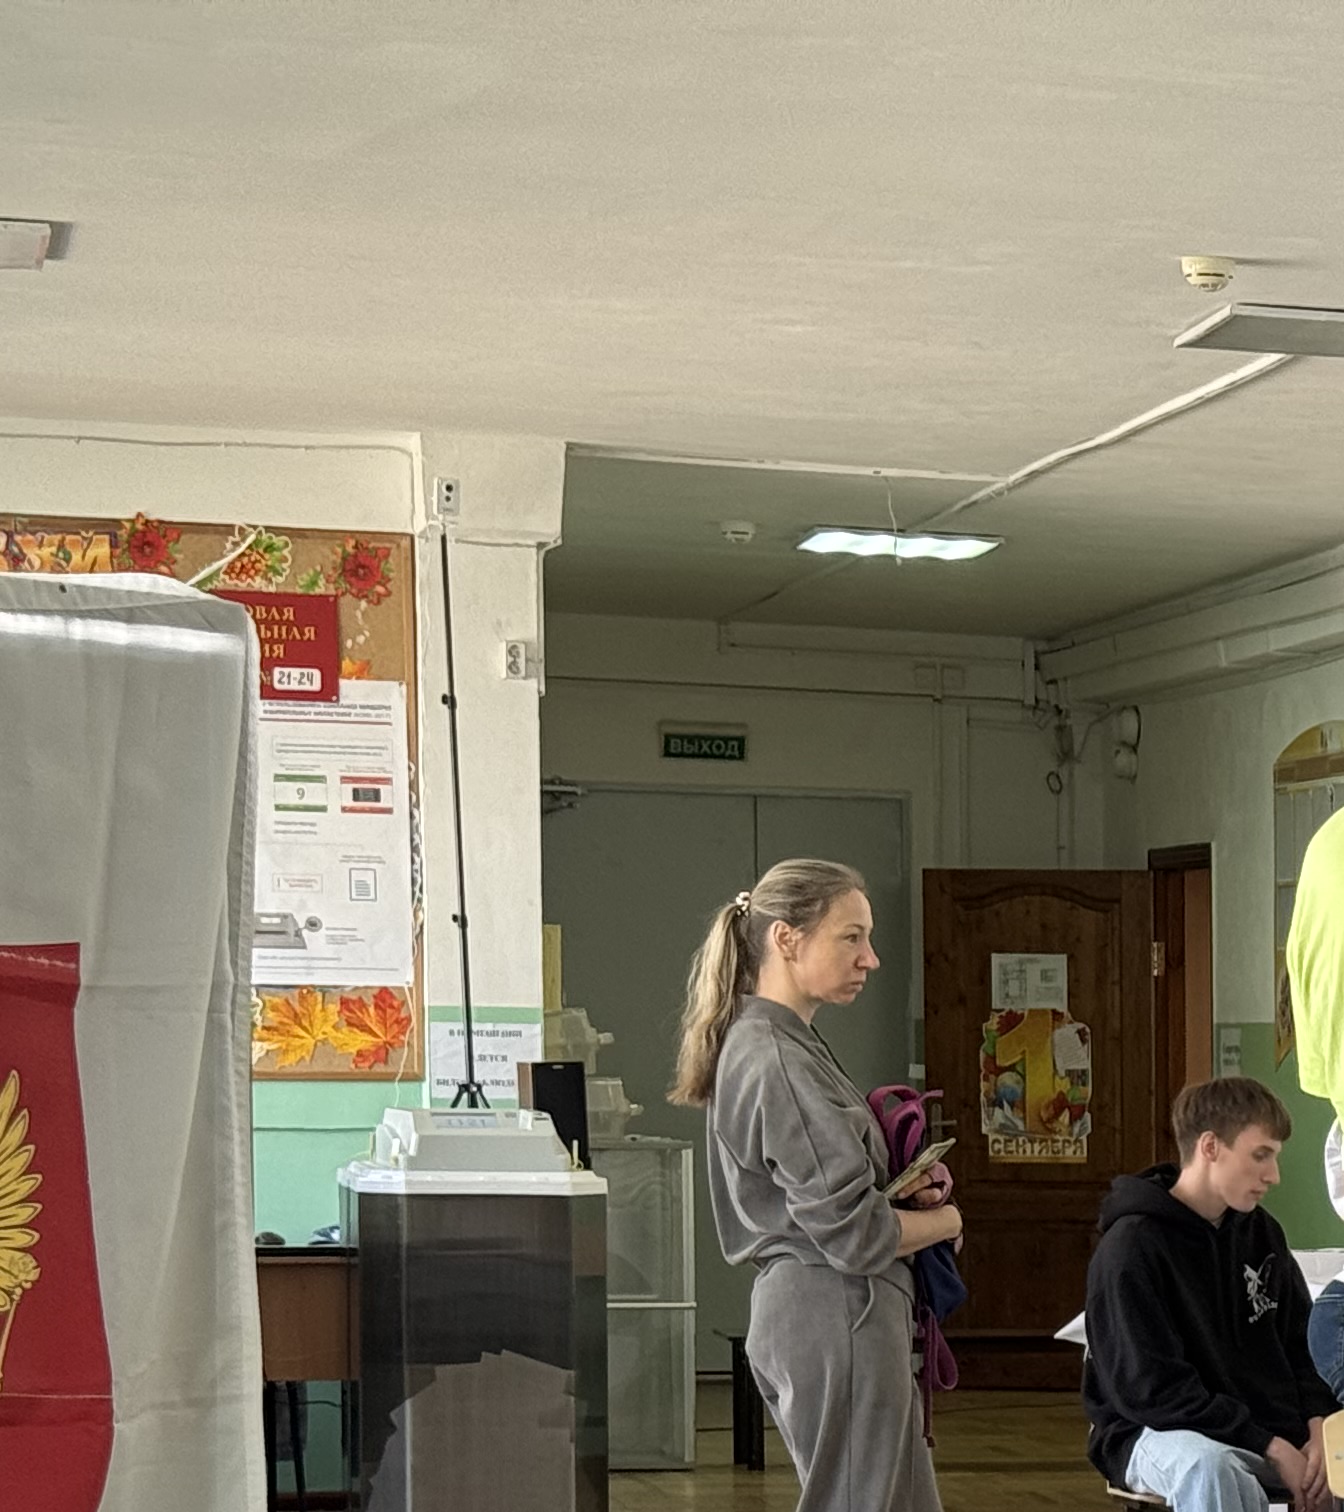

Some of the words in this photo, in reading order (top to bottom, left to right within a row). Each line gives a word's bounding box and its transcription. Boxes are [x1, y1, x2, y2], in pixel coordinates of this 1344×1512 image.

[277, 671, 314, 686] 21-24
[669, 738, 740, 758] ВЫХОД
[296, 787, 305, 800] 9
[990, 1138, 1085, 1156] СЕНТЯБРЯ
